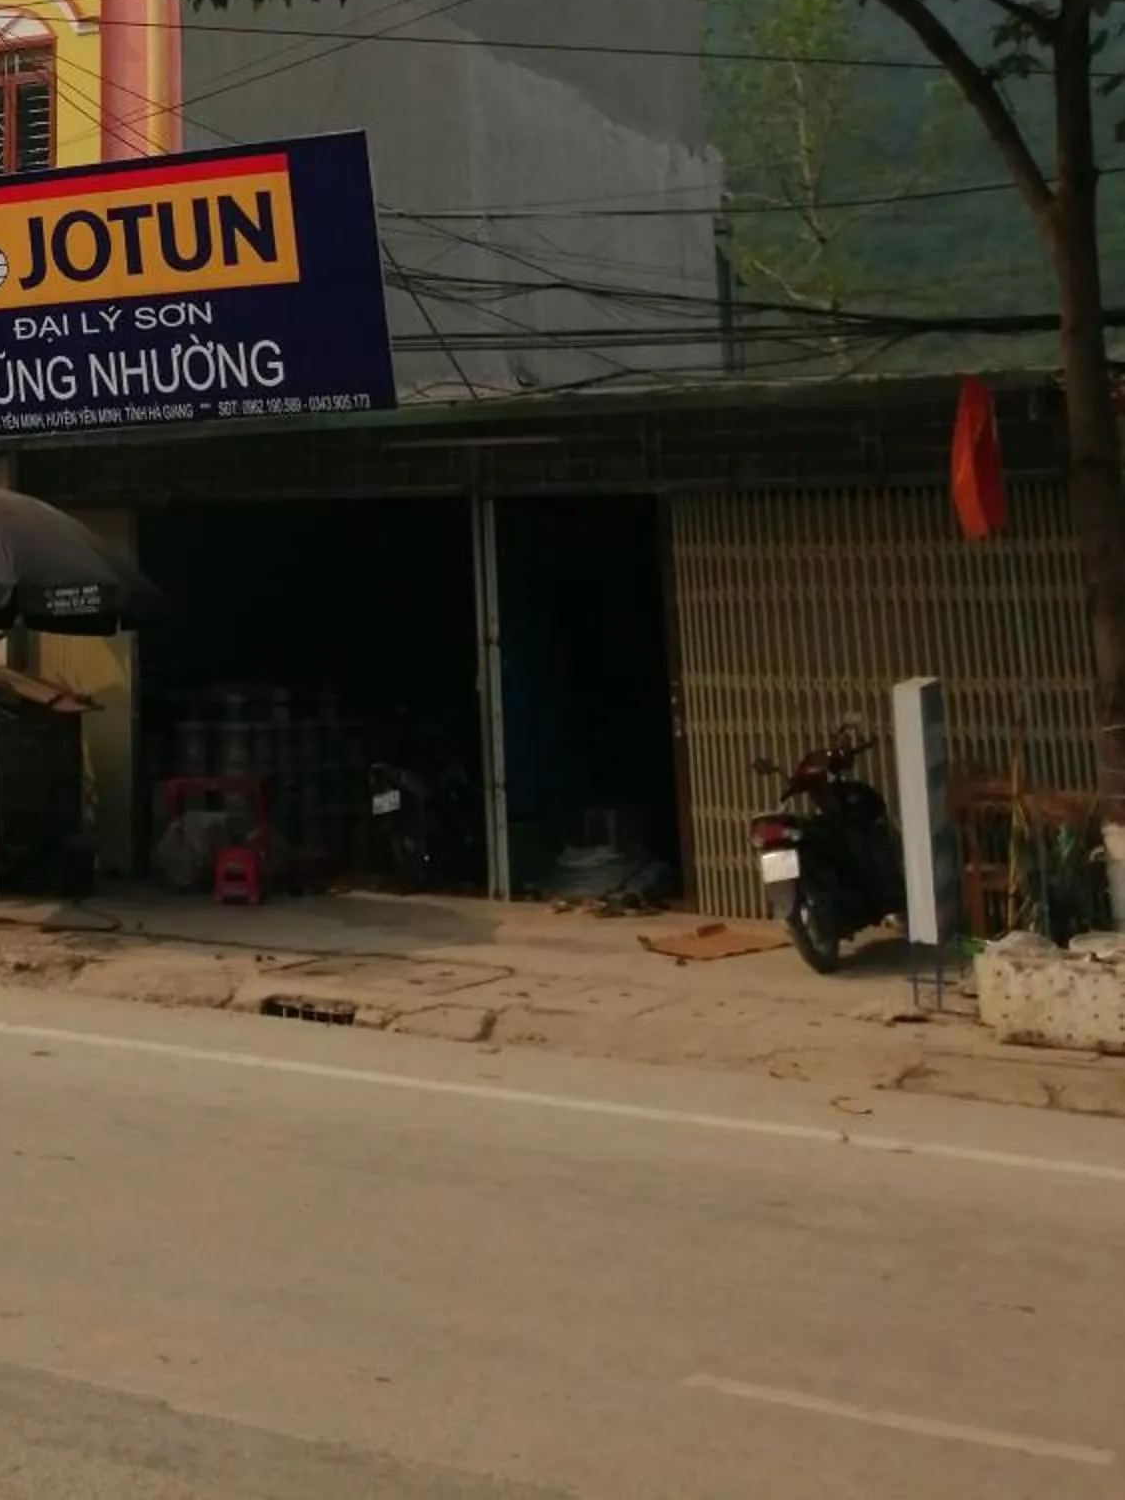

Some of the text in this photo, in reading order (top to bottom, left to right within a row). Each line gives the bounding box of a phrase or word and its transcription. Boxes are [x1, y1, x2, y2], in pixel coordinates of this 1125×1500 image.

[19, 191, 279, 290] JOTUN
[13, 300, 213, 343] ĐẠI LÝ SƠN
[88, 333, 286, 396] NHƯỜNG
